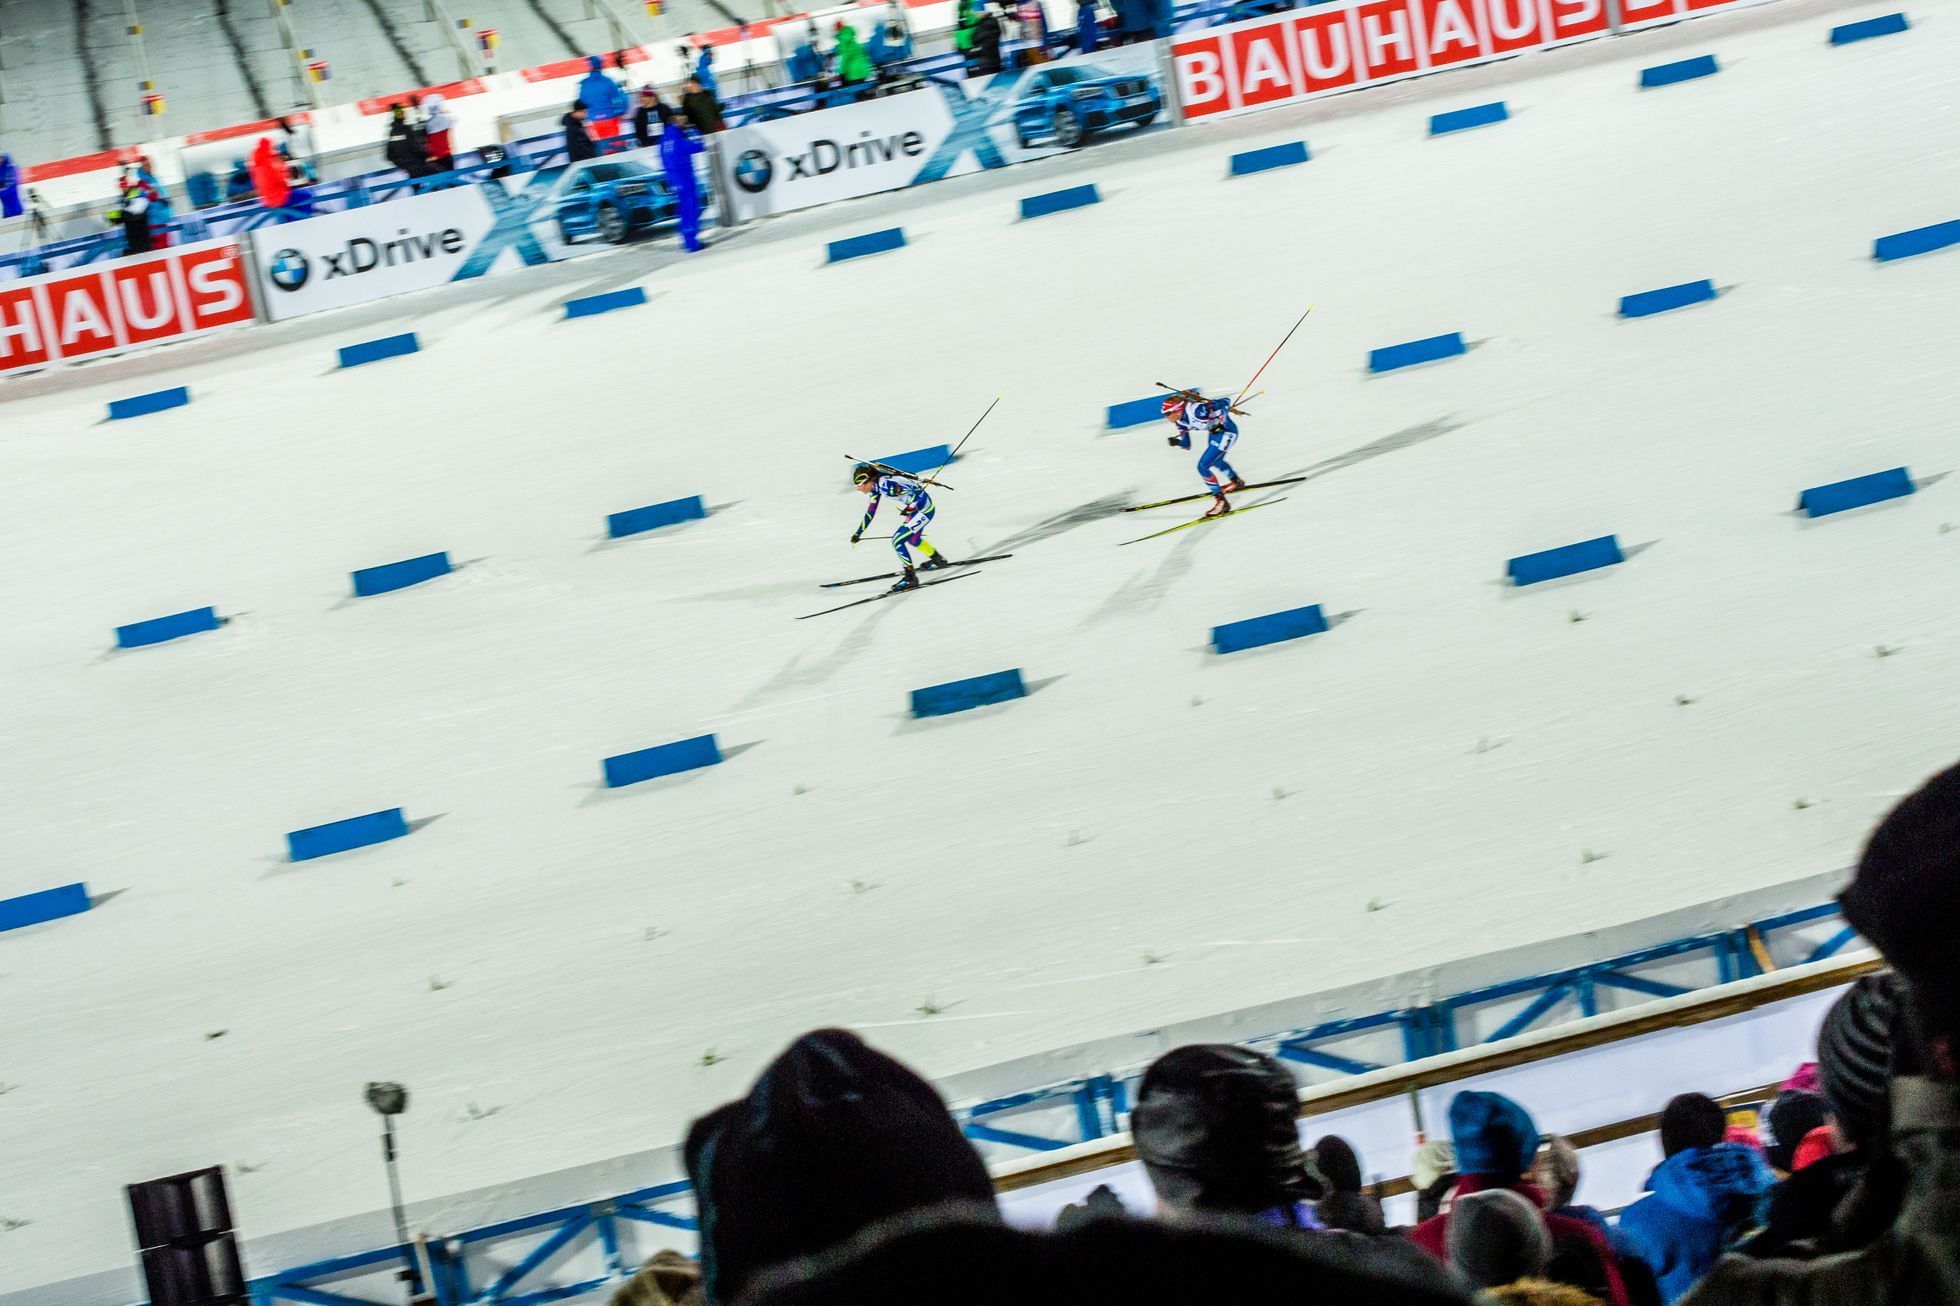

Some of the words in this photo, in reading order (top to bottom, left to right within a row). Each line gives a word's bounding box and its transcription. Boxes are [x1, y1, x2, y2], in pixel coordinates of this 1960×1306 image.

[784, 130, 924, 182] xDrive
[320, 227, 467, 281] xDrive
[0, 256, 245, 357] HAUS
